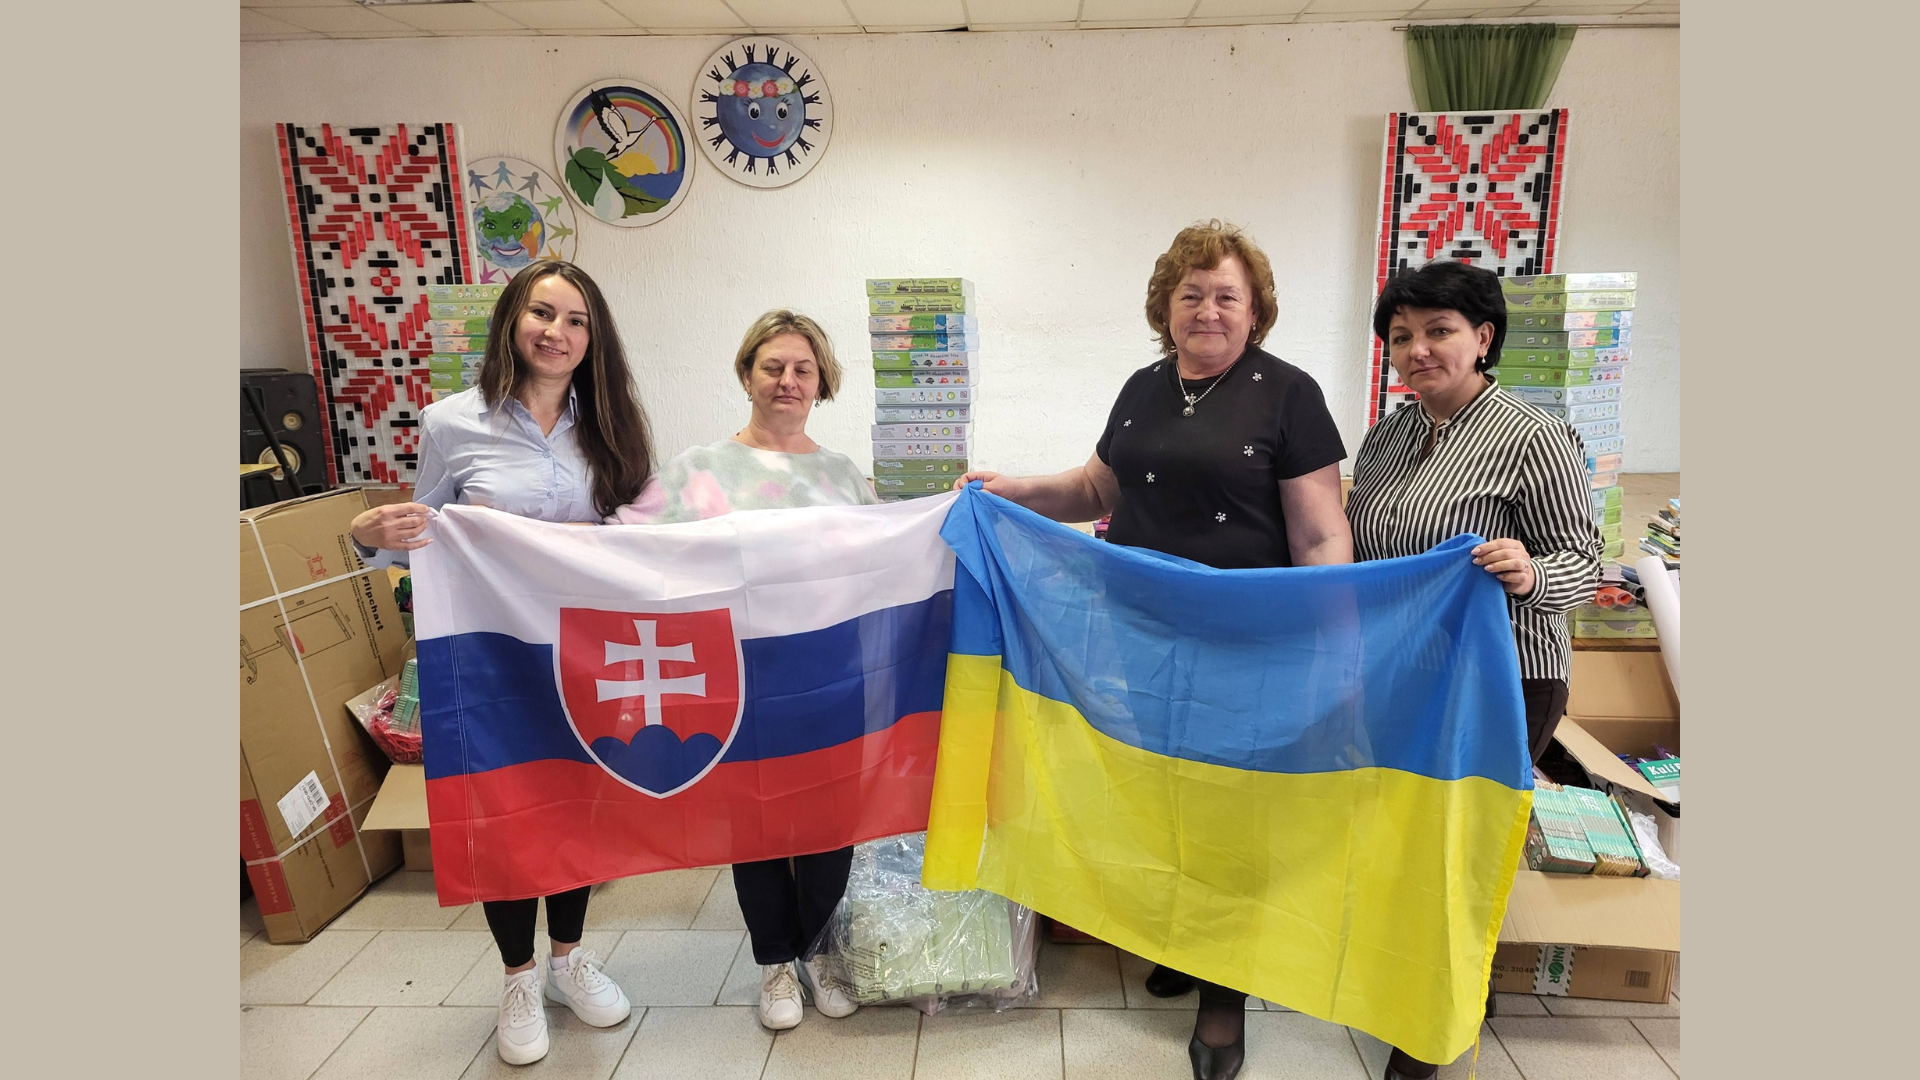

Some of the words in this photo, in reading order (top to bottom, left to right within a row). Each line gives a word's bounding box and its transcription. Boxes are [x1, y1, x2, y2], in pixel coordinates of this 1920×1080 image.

[362, 576, 384, 631] Flipchart
[334, 799, 345, 814] DO
[244, 812, 254, 831] CARE
[339, 816, 352, 834] NOT
[250, 831, 261, 849] WITH
[258, 848, 270, 877] HANLE
[267, 877, 279, 903] PLEASE
